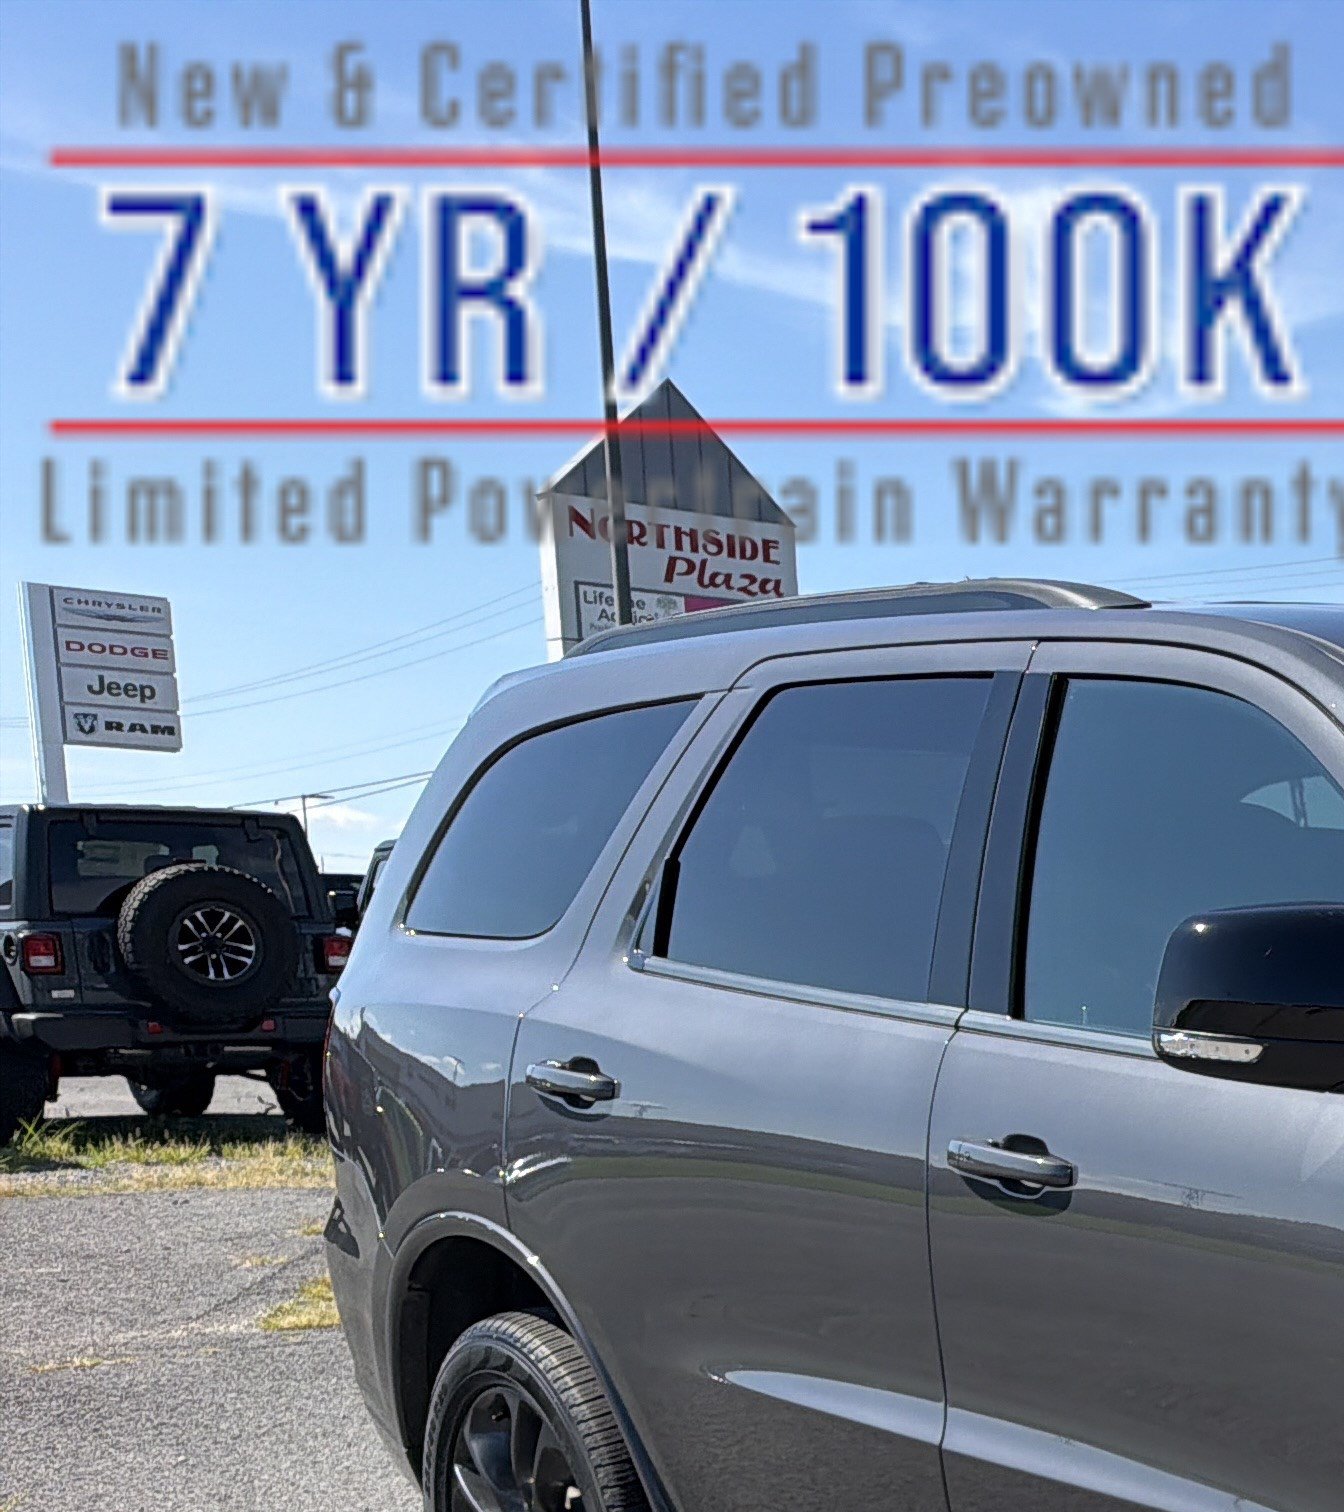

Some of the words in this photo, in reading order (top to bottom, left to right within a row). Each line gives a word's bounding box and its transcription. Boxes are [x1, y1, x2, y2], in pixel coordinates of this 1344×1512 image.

[663, 555, 785, 598] Plaza
[63, 597, 162, 614] CHRYSLER
[65, 640, 169, 660] DODGE
[87, 674, 156, 703] Jeep
[104, 720, 176, 736] RAM
